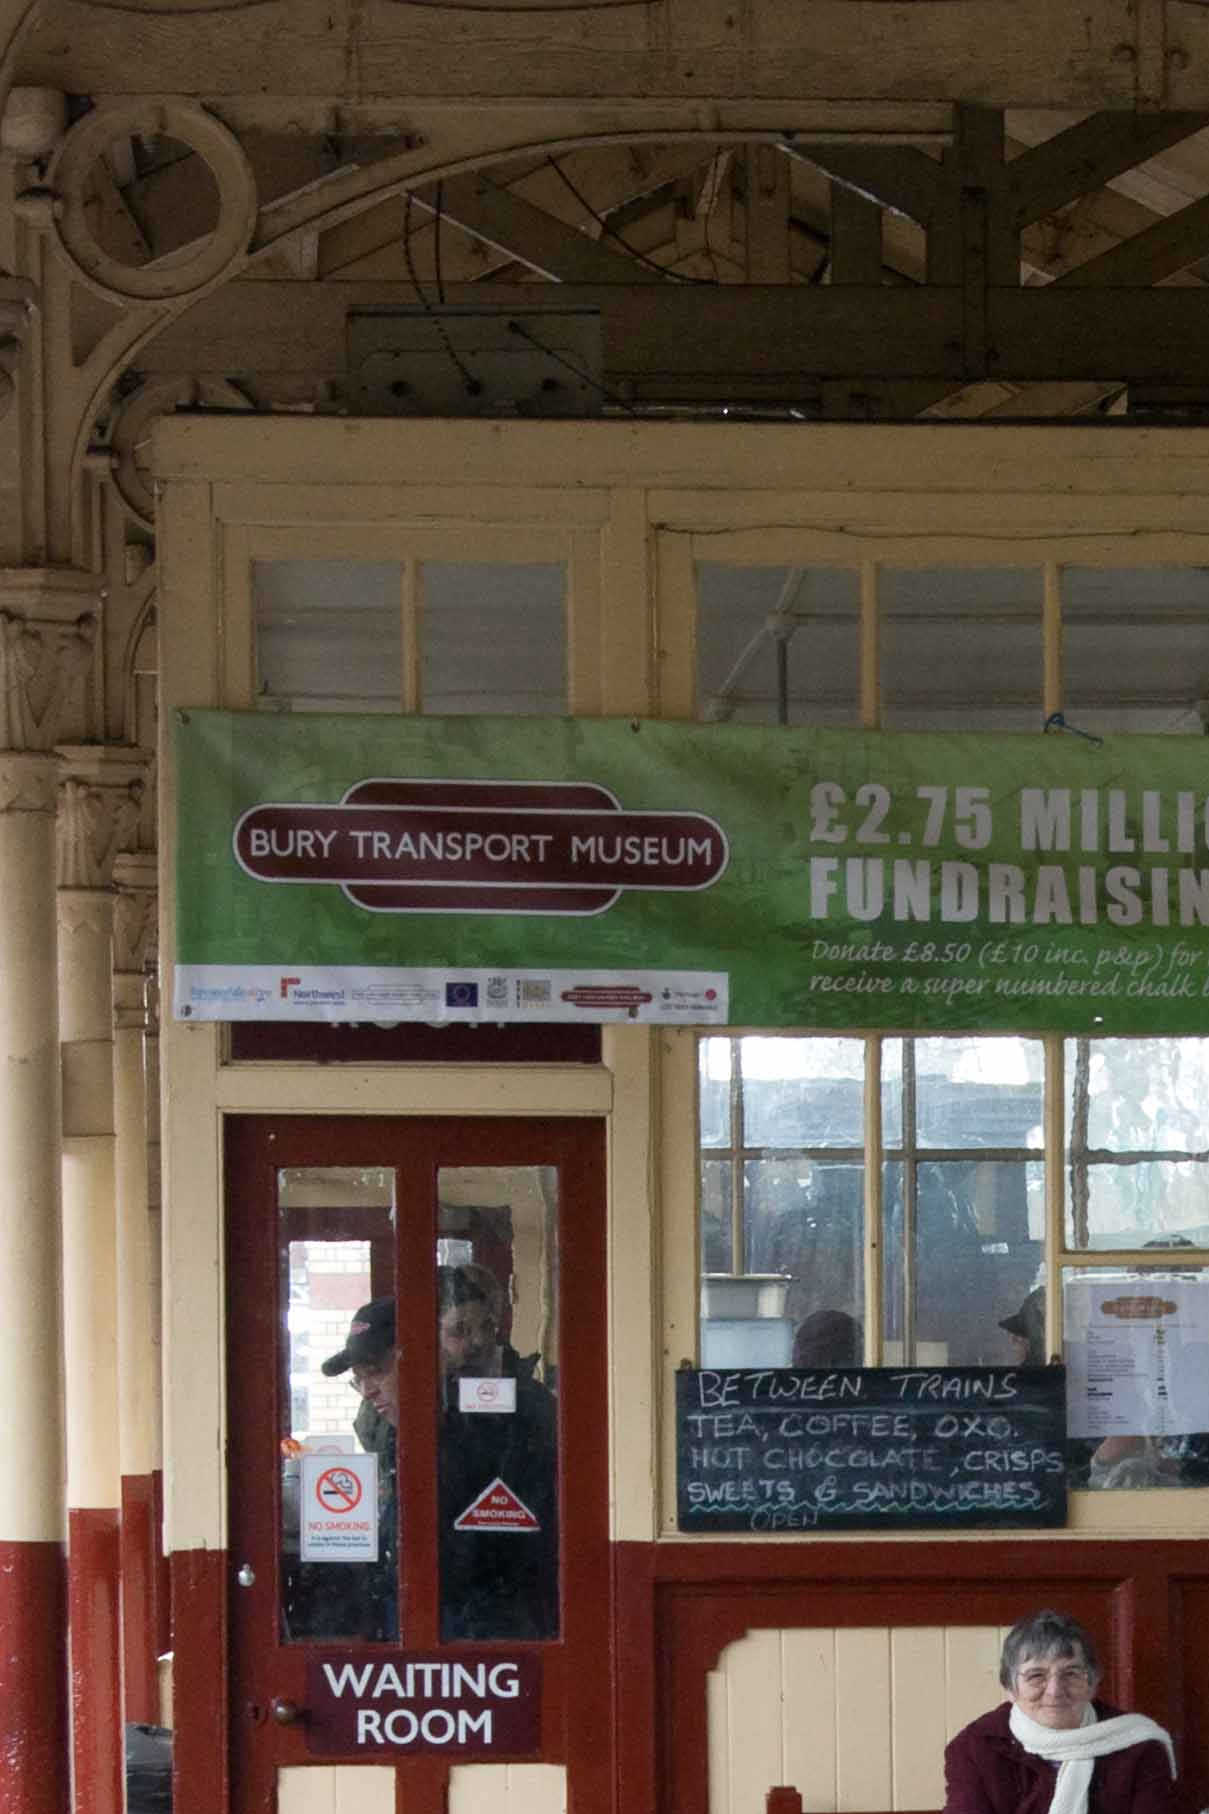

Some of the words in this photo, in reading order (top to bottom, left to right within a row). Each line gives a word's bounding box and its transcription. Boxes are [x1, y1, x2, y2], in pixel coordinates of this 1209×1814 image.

[810, 782, 993, 849] £2.75
[250, 830, 337, 860] BURY
[348, 831, 553, 863] TRANSPORT
[570, 836, 712, 867] MUSEUM
[812, 940, 896, 962] Donate
[903, 941, 972, 964] £8.50
[1045, 943, 1089, 965] inc.
[1161, 943, 1202, 979] for
[809, 971, 896, 993] receive
[900, 974, 919, 993] a
[923, 975, 990, 1006] super
[995, 972, 1121, 997] numbered
[1126, 973, 1196, 998] chalk
[698, 1371, 862, 1407] BETWEEN
[890, 1373, 1018, 1400] TRAINS
[687, 1412, 769, 1443] TEA,
[778, 1415, 918, 1441] COFFEE,
[690, 1448, 752, 1471] HOT
[490, 1495, 509, 1505] NO
[687, 1480, 795, 1502] SWEETS
[852, 1481, 1041, 1502] SANDWICHES
[472, 1508, 526, 1520] SMOKING
[750, 1511, 820, 1531] OPEN
[322, 1662, 520, 1699] WAITING
[356, 1708, 492, 1745] ROOM
